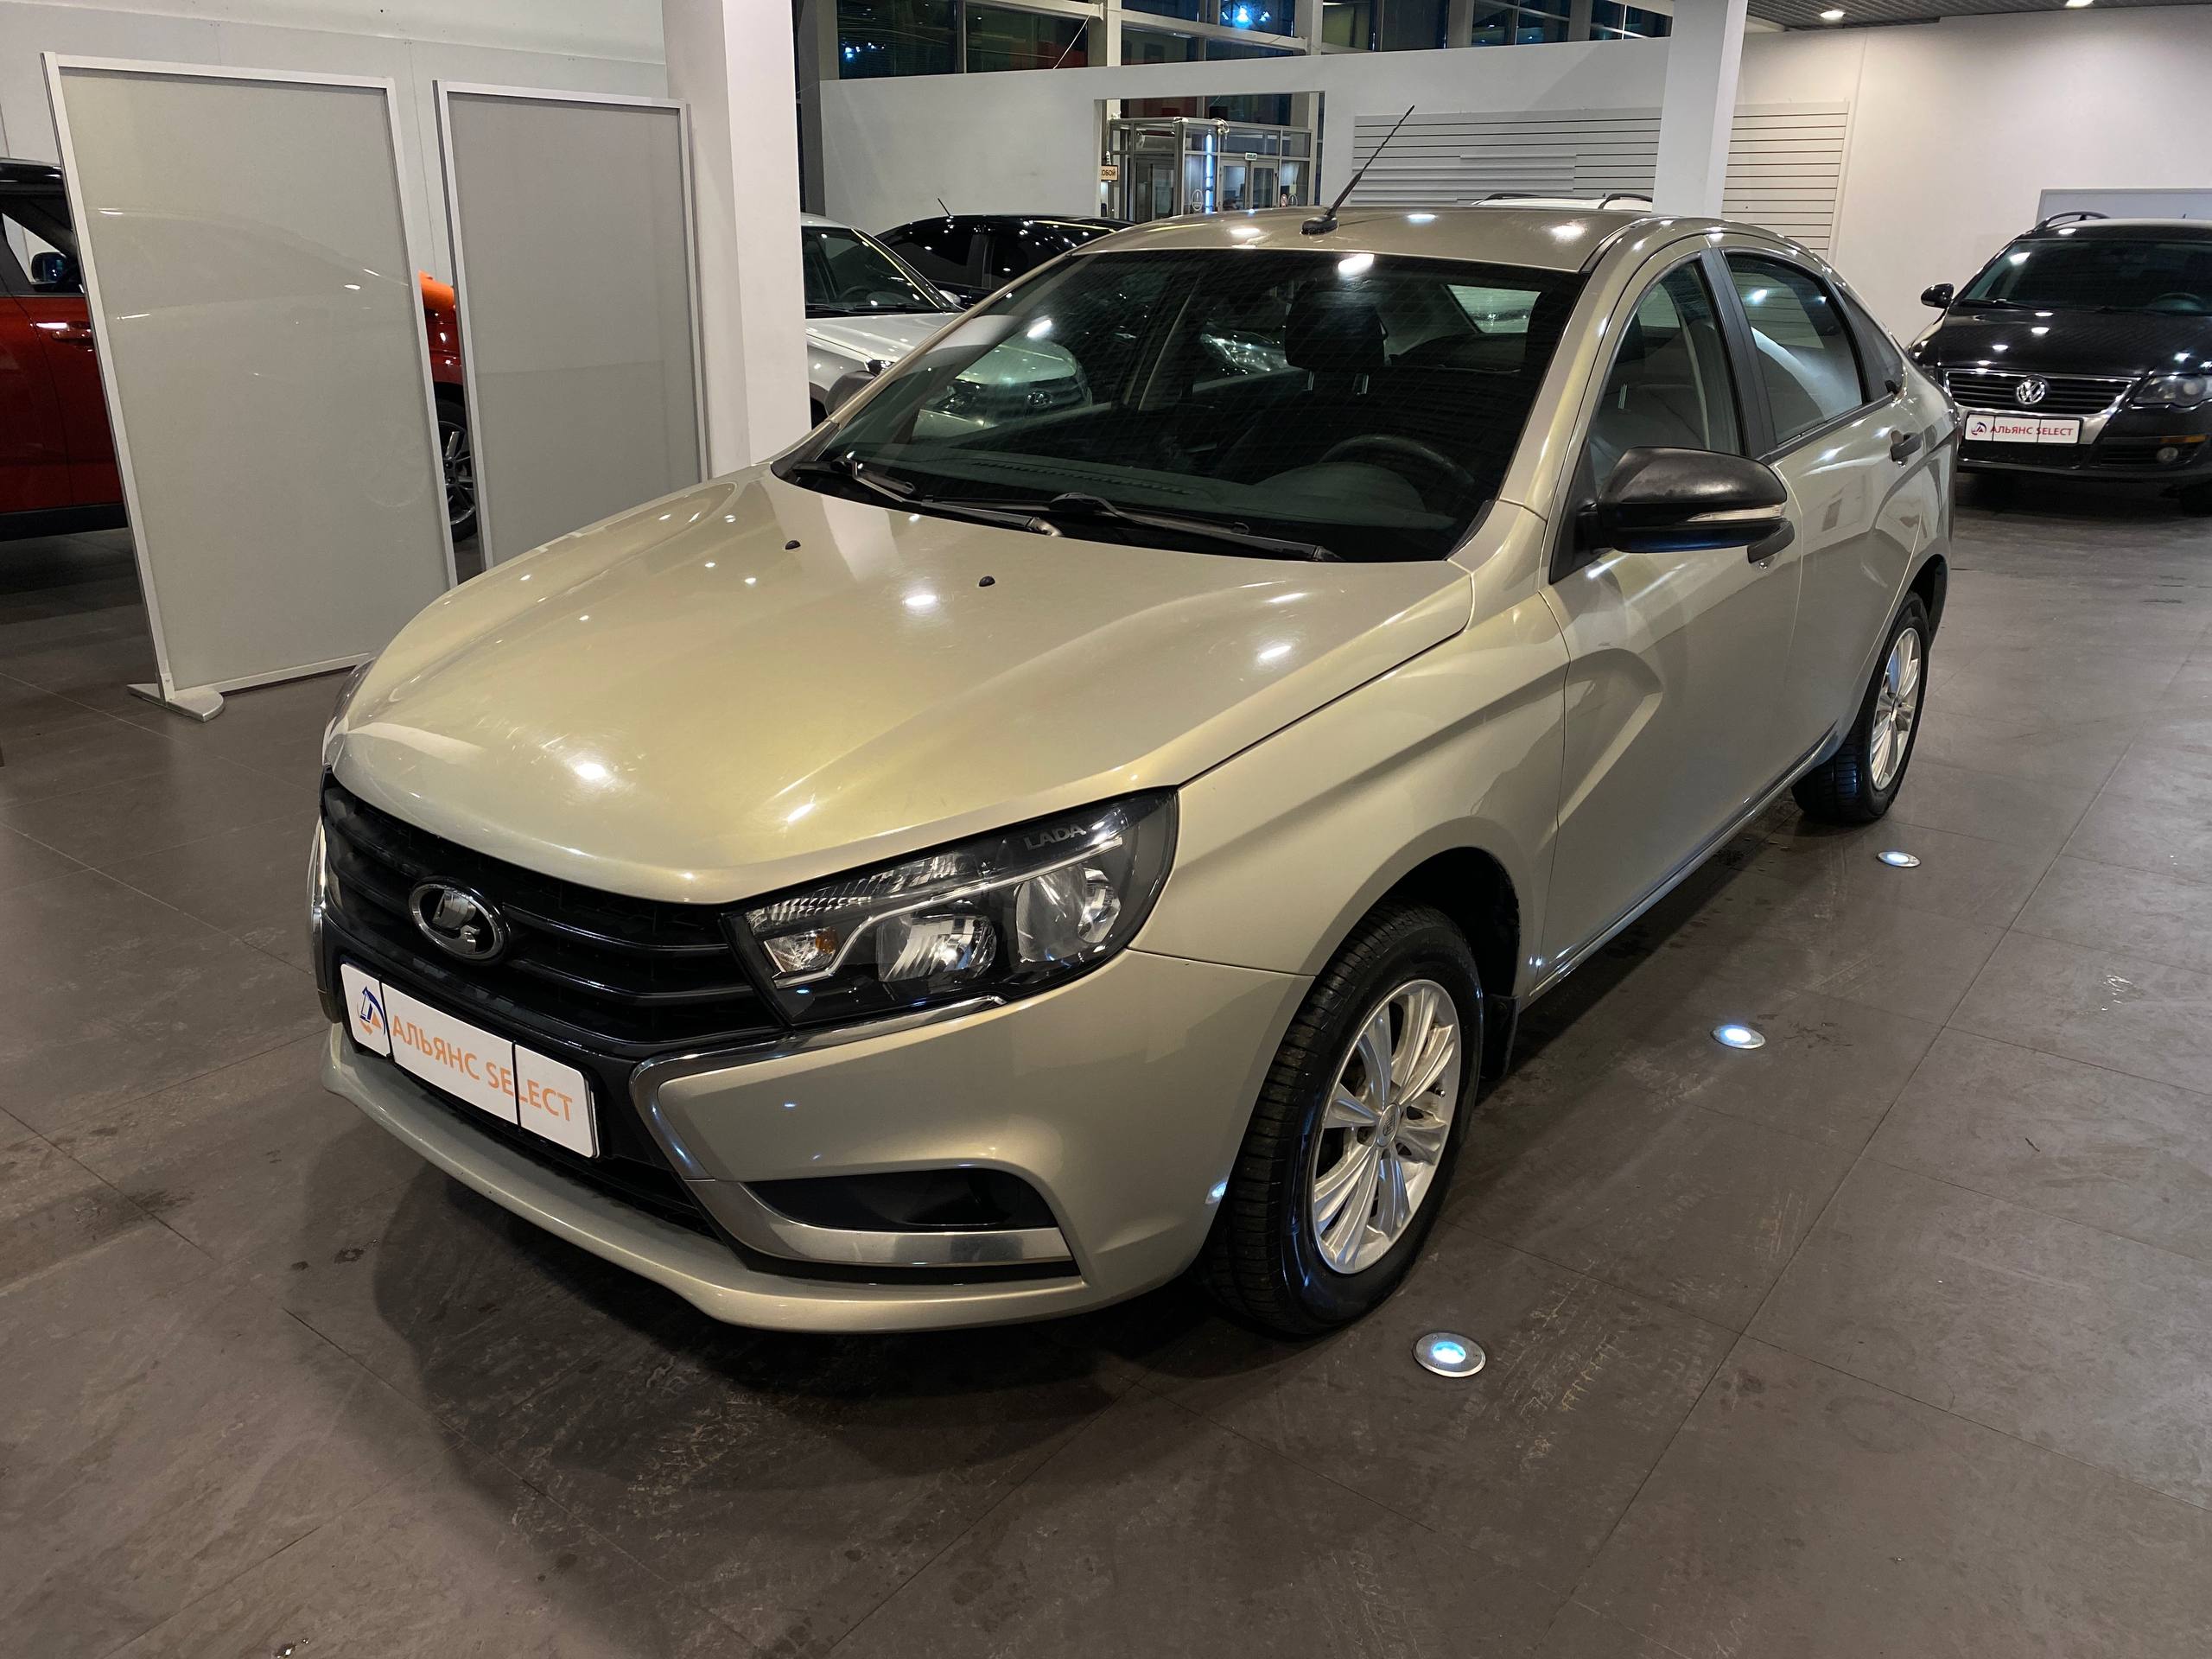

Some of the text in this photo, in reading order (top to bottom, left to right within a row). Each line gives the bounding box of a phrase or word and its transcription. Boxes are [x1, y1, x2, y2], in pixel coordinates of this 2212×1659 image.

[1990, 425, 2074, 436] АЛЬЯНС SELECT
[1024, 823, 1086, 850] LADA
[392, 1015, 480, 1080] АЛЬЯНС
